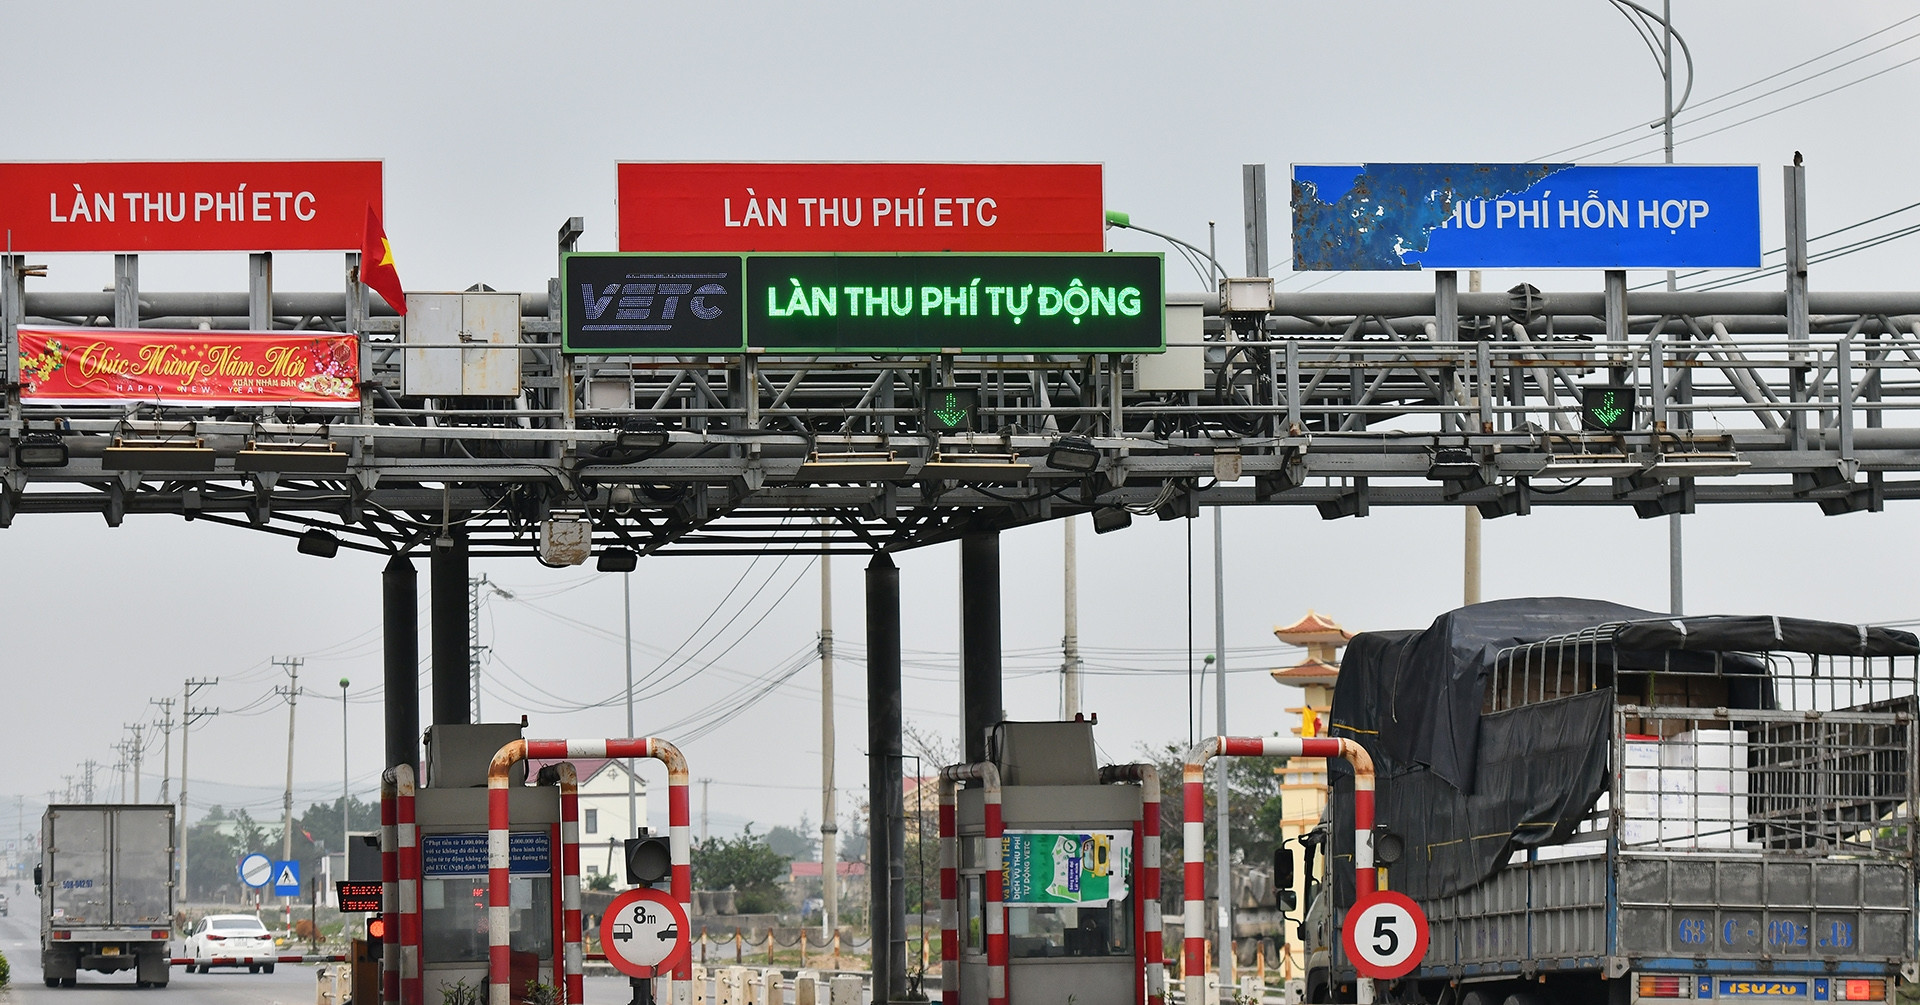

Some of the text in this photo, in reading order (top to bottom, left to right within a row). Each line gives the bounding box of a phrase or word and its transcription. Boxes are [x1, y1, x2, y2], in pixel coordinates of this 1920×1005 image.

[50, 183, 316, 222] LÀN THU PHÍ ETC
[724, 188, 998, 227] LÀN THU PHÍ ETC
[1496, 190, 1551, 229] PHÍ
[1558, 190, 1629, 229] HỖN
[1638, 200, 1710, 234] HỢP
[581, 283, 728, 320] VETC
[768, 278, 1141, 325] LÀN THU PHÍ TỰ ĐỘNG
[78, 341, 308, 386] Chúc Mừng Năm Mới
[633, 906, 656, 924] 8m
[1679, 918, 1706, 944] 63
[1372, 916, 1398, 956] 5
[1729, 982, 1797, 995] ISUZU
